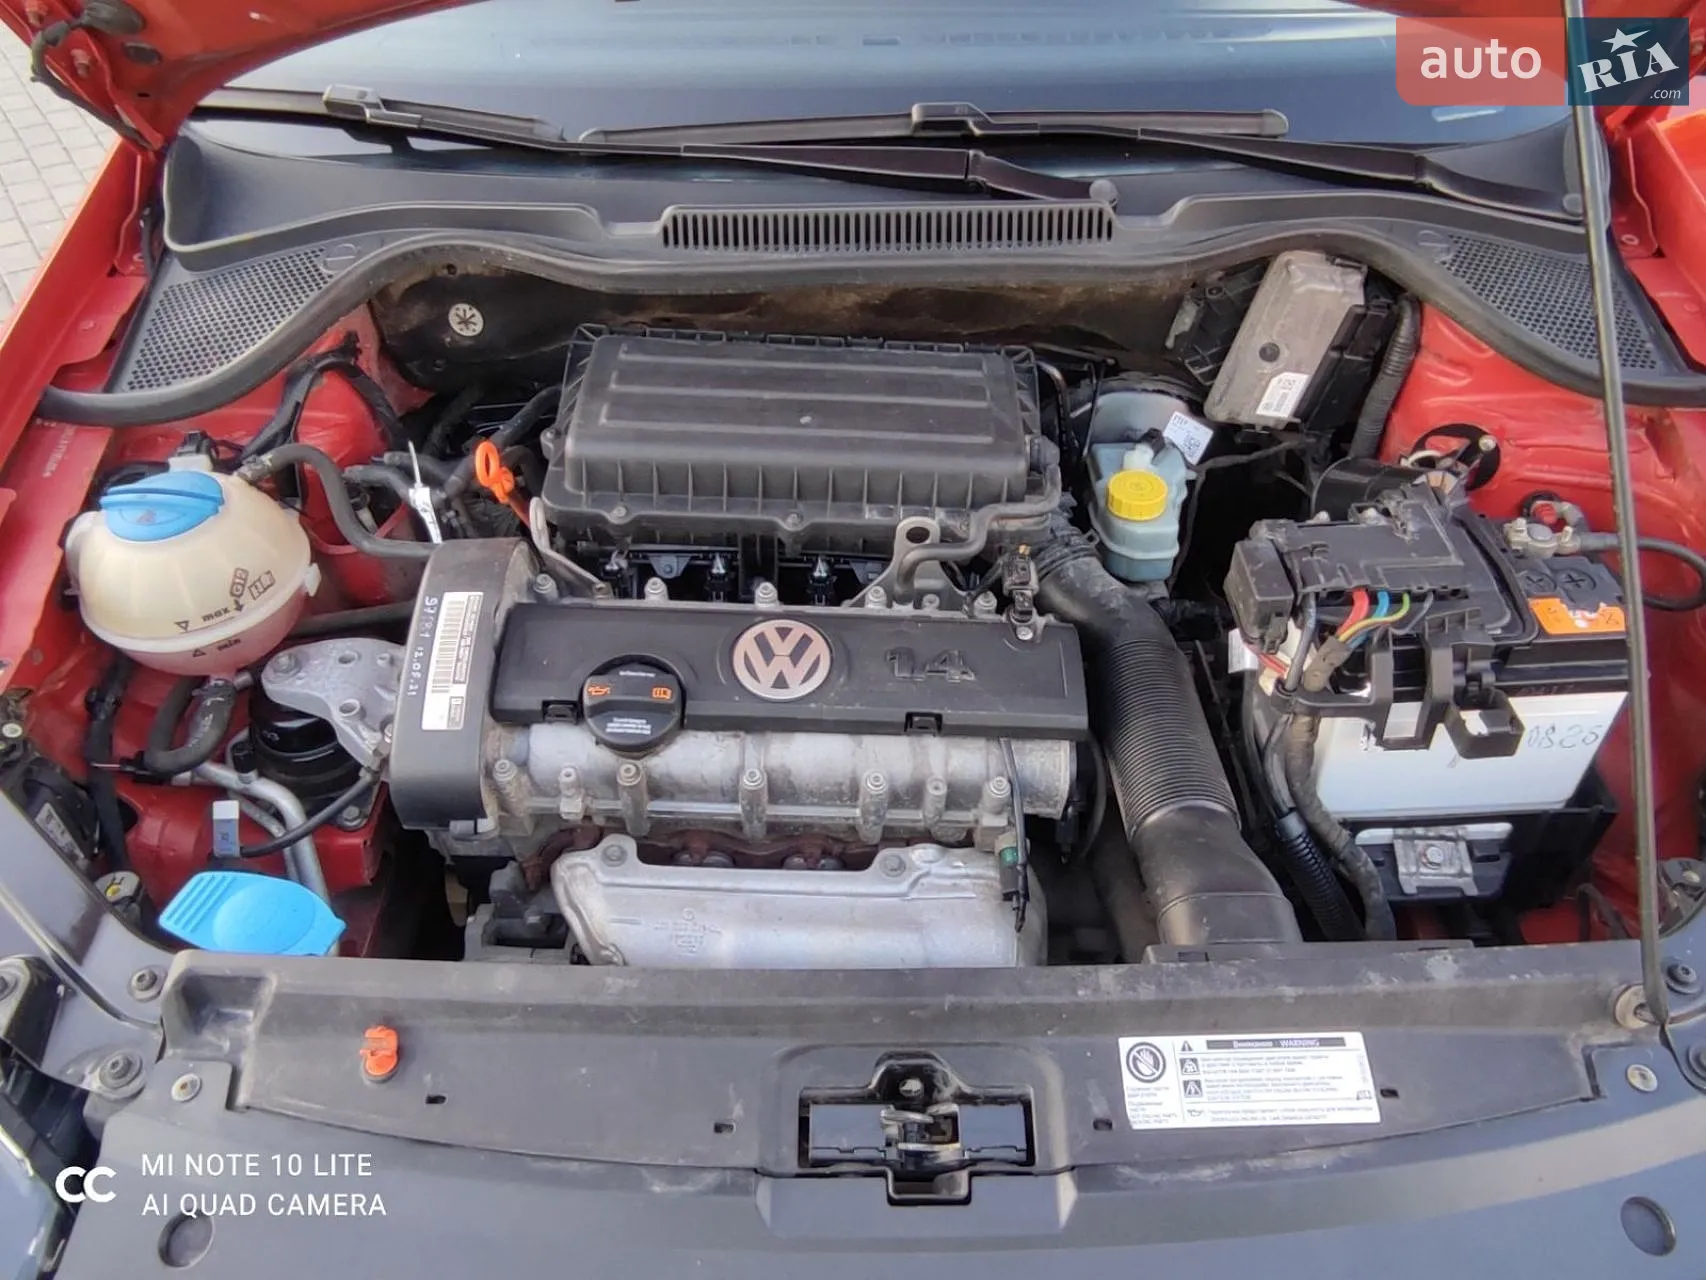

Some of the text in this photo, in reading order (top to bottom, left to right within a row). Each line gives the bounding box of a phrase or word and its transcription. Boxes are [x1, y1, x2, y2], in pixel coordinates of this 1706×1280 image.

[201, 606, 231, 623] max
[216, 637, 242, 652] min
[733, 618, 833, 700] VW
